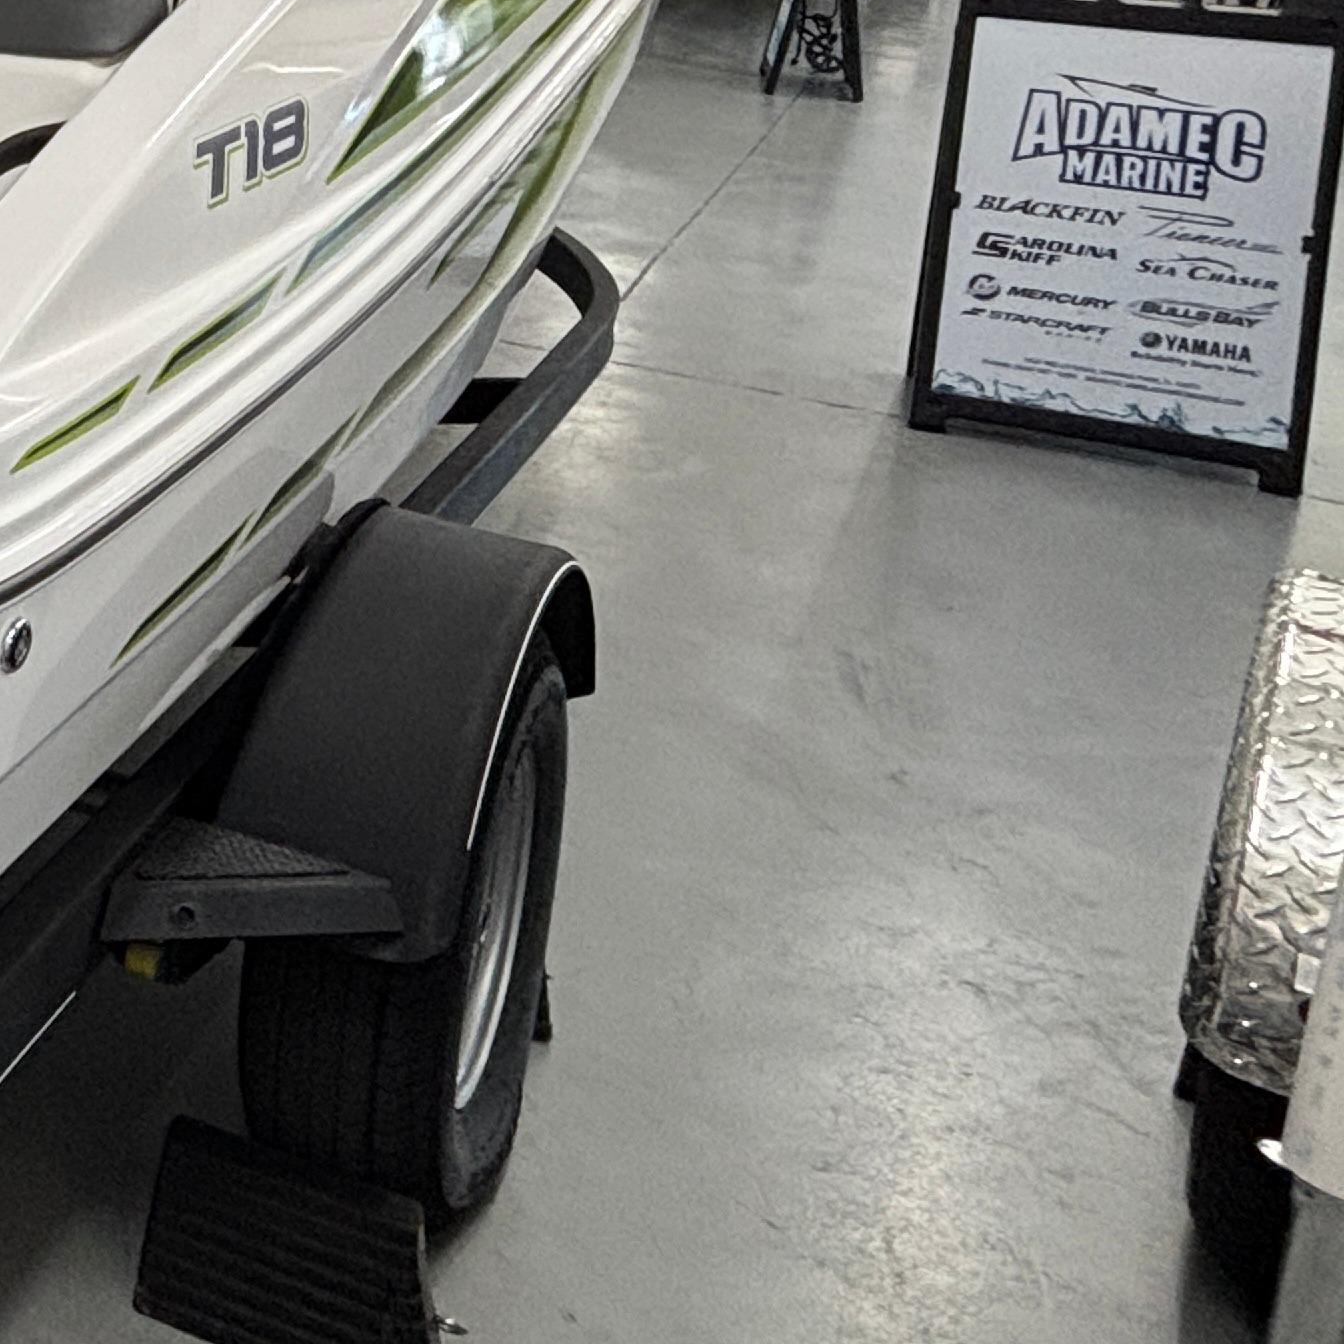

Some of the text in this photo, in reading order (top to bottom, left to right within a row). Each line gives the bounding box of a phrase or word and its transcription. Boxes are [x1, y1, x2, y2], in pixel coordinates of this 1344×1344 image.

[1011, 89, 1267, 182] ADAMEC
[194, 96, 309, 208] T18
[1059, 149, 1210, 201] MARINE
[975, 194, 1126, 226] BLACKFIN
[1007, 286, 1117, 310] MERCURY
[988, 310, 1111, 336] STARCRAFT
[1165, 334, 1252, 363] YAMAHA
